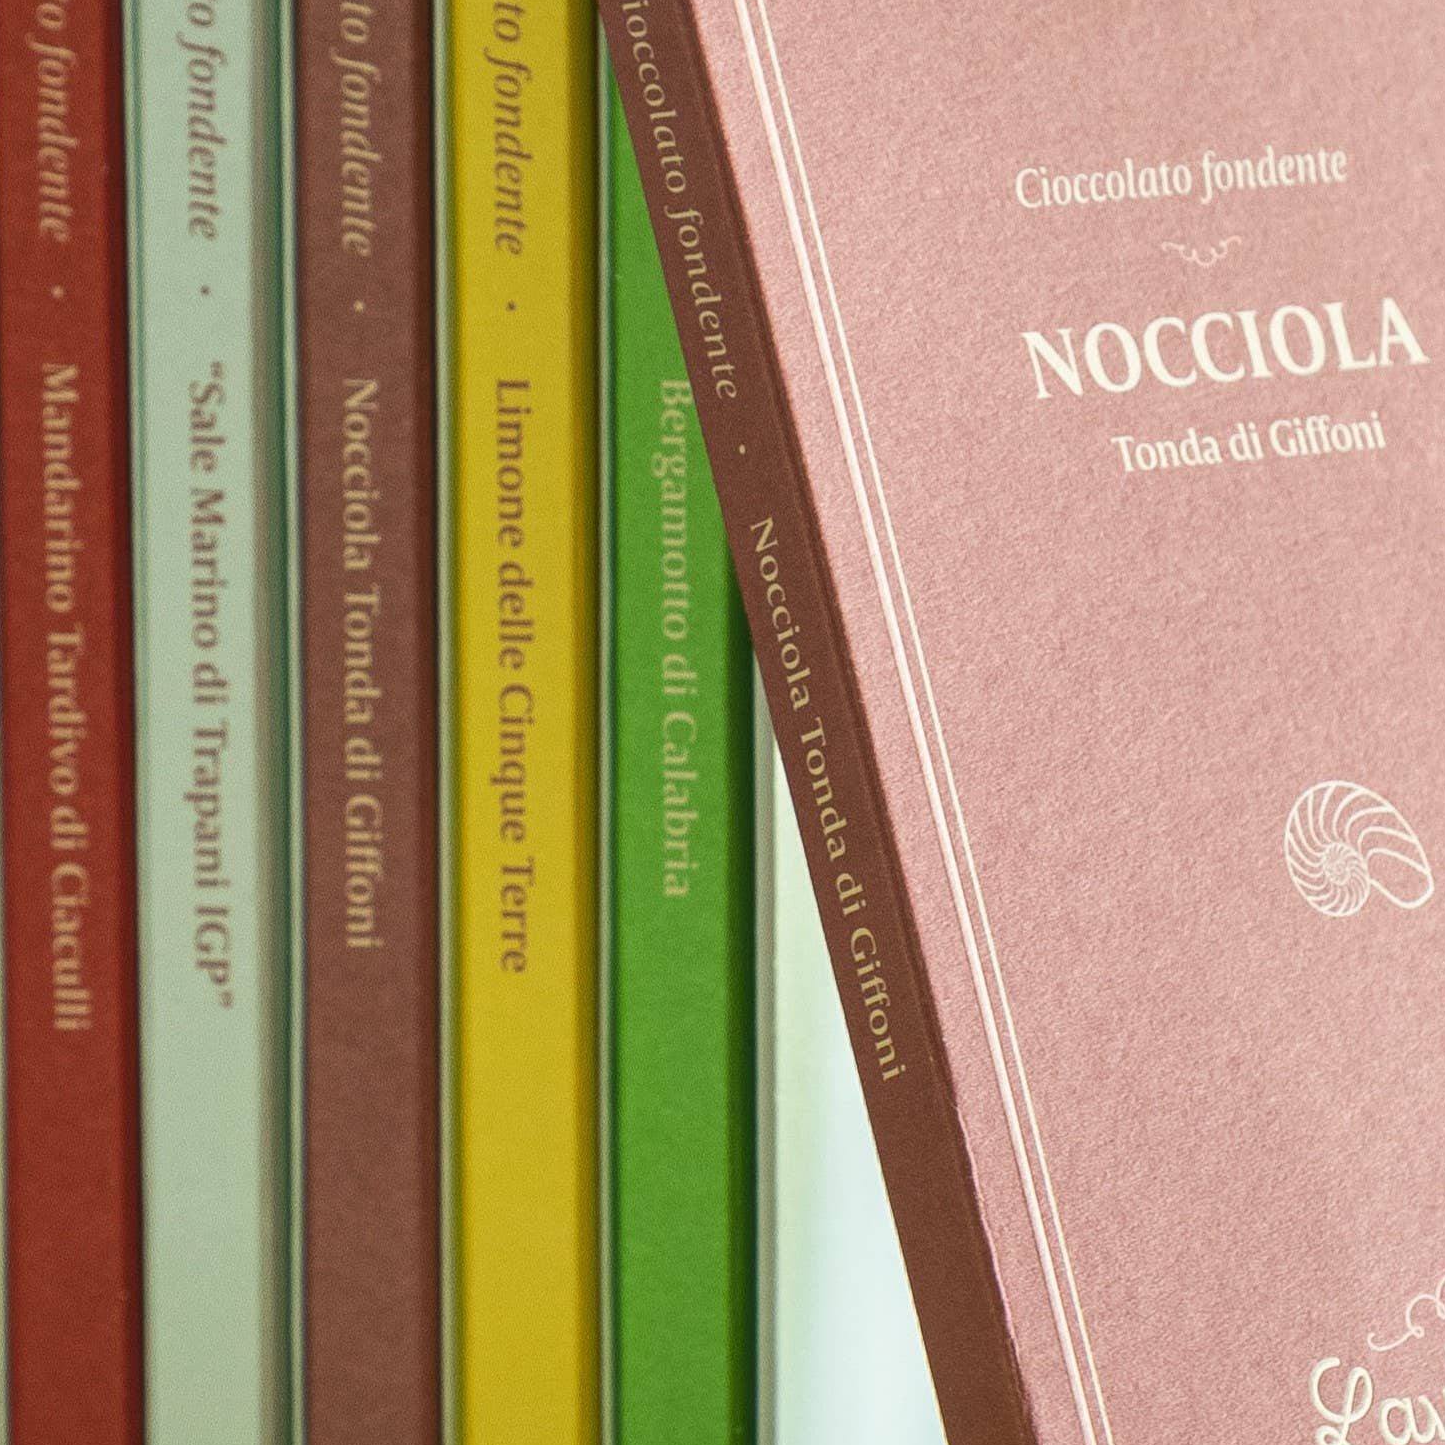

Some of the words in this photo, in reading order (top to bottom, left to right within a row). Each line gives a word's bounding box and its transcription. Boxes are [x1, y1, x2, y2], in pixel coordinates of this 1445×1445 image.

[24, 33, 79, 242] fondente
[176, 31, 228, 242] fondente
[328, 47, 383, 256] fondente
[483, 48, 534, 256] fondente
[1014, 152, 1193, 210] Cioccolato
[1199, 144, 1348, 204] fondente
[664, 206, 738, 400] fondente
[1020, 296, 1430, 400] NOCCIOLA
[41, 362, 81, 613] Mandarino
[341, 377, 383, 571] Nocciola
[494, 377, 534, 548] Limone
[650, 377, 693, 640] Bergamotto
[1111, 428, 1223, 474] Tonda
[1229, 421, 1263, 461] di
[1269, 410, 1386, 458] Giffoni
[190, 487, 229, 648] Marino
[496, 560, 535, 670] delle
[749, 516, 812, 712] Nocciola
[43, 622, 88, 796] Tardivo
[192, 662, 231, 707] di
[343, 585, 384, 724] Tonda
[659, 655, 700, 698] di
[50, 805, 89, 851] di
[183, 721, 232, 890] Trapani
[344, 736, 385, 781] di
[490, 682, 536, 844] Cinque
[659, 711, 700, 898] Calabria
[798, 716, 849, 862] Tonda
[50, 861, 92, 1031] Ciaculli
[344, 793, 387, 948] Giffoni
[499, 856, 537, 973] Terre
[834, 872, 868, 917] di
[849, 926, 907, 1082] Giffoni
